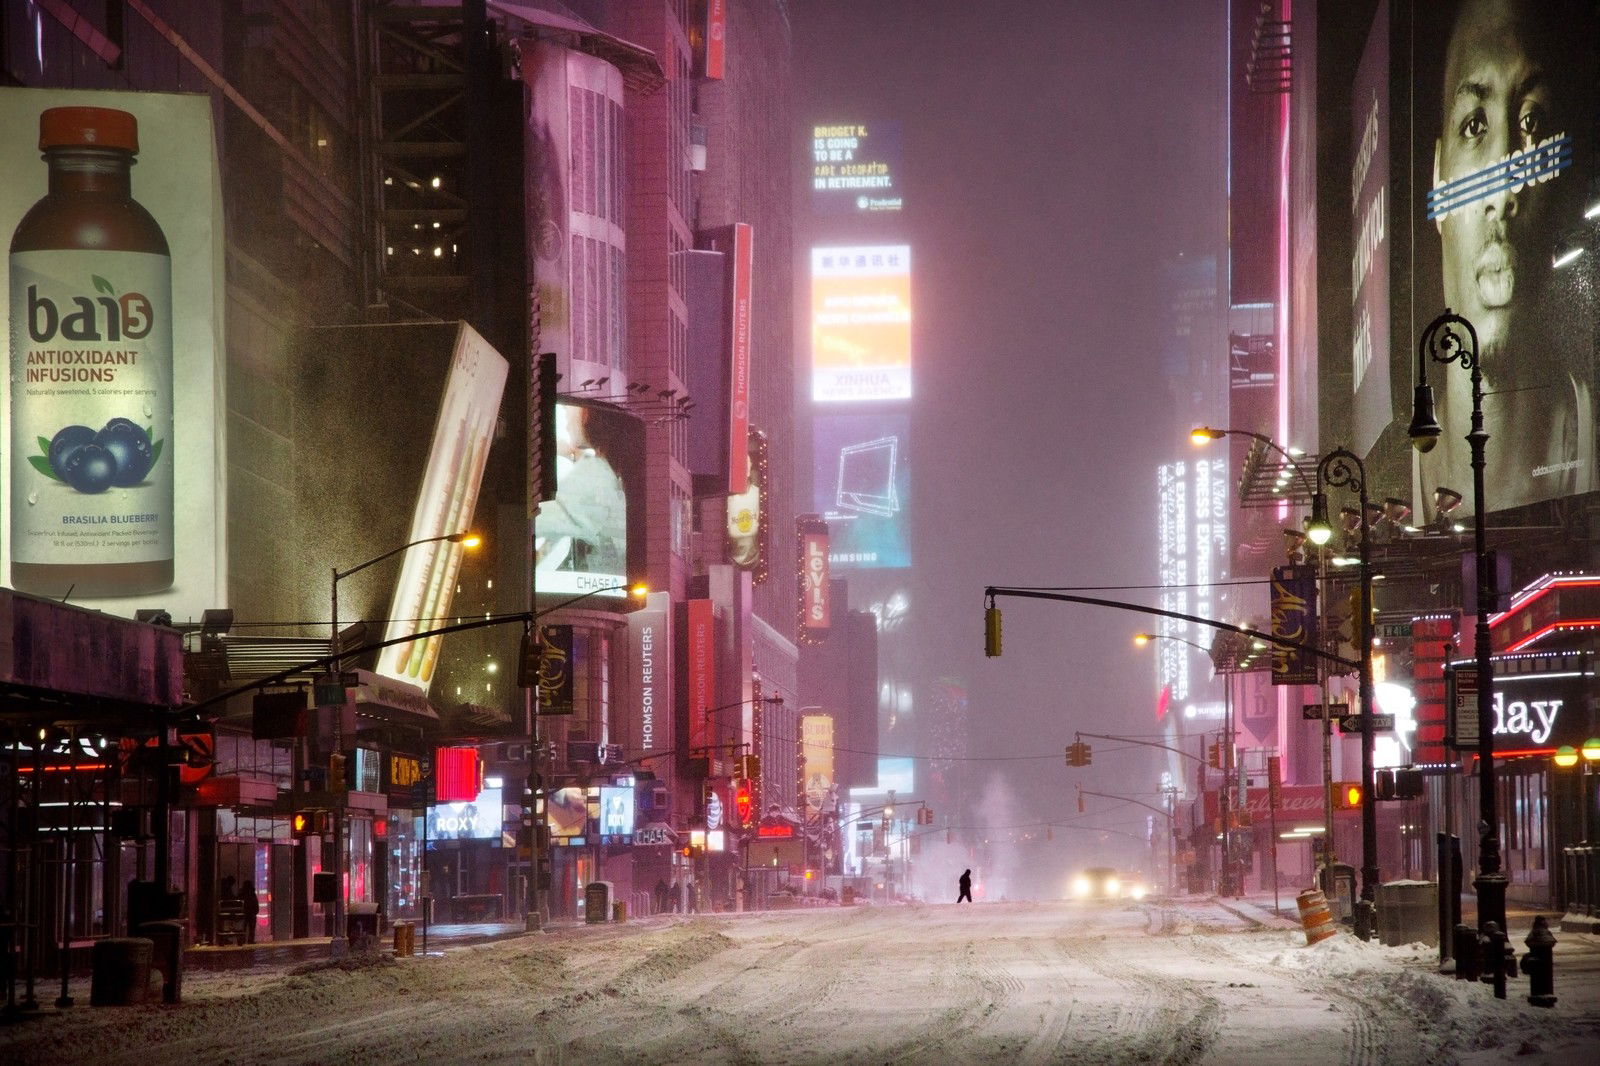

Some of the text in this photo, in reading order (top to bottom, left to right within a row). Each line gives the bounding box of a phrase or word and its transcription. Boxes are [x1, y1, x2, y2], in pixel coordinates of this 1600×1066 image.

[1433, 131, 1565, 224] superstar
[26, 350, 138, 365] ANTIOXIDANT
[738, 345, 746, 393] THOMSON
[62, 513, 159, 524] BRASILIA BLUEBERRY
[1176, 482, 1186, 554] EXPRESS
[577, 576, 611, 589] CHASE
[1196, 524, 1209, 597] EXPRESS
[643, 627, 652, 750] THOMSON REUTERS
[437, 817, 478, 831] ROXY
